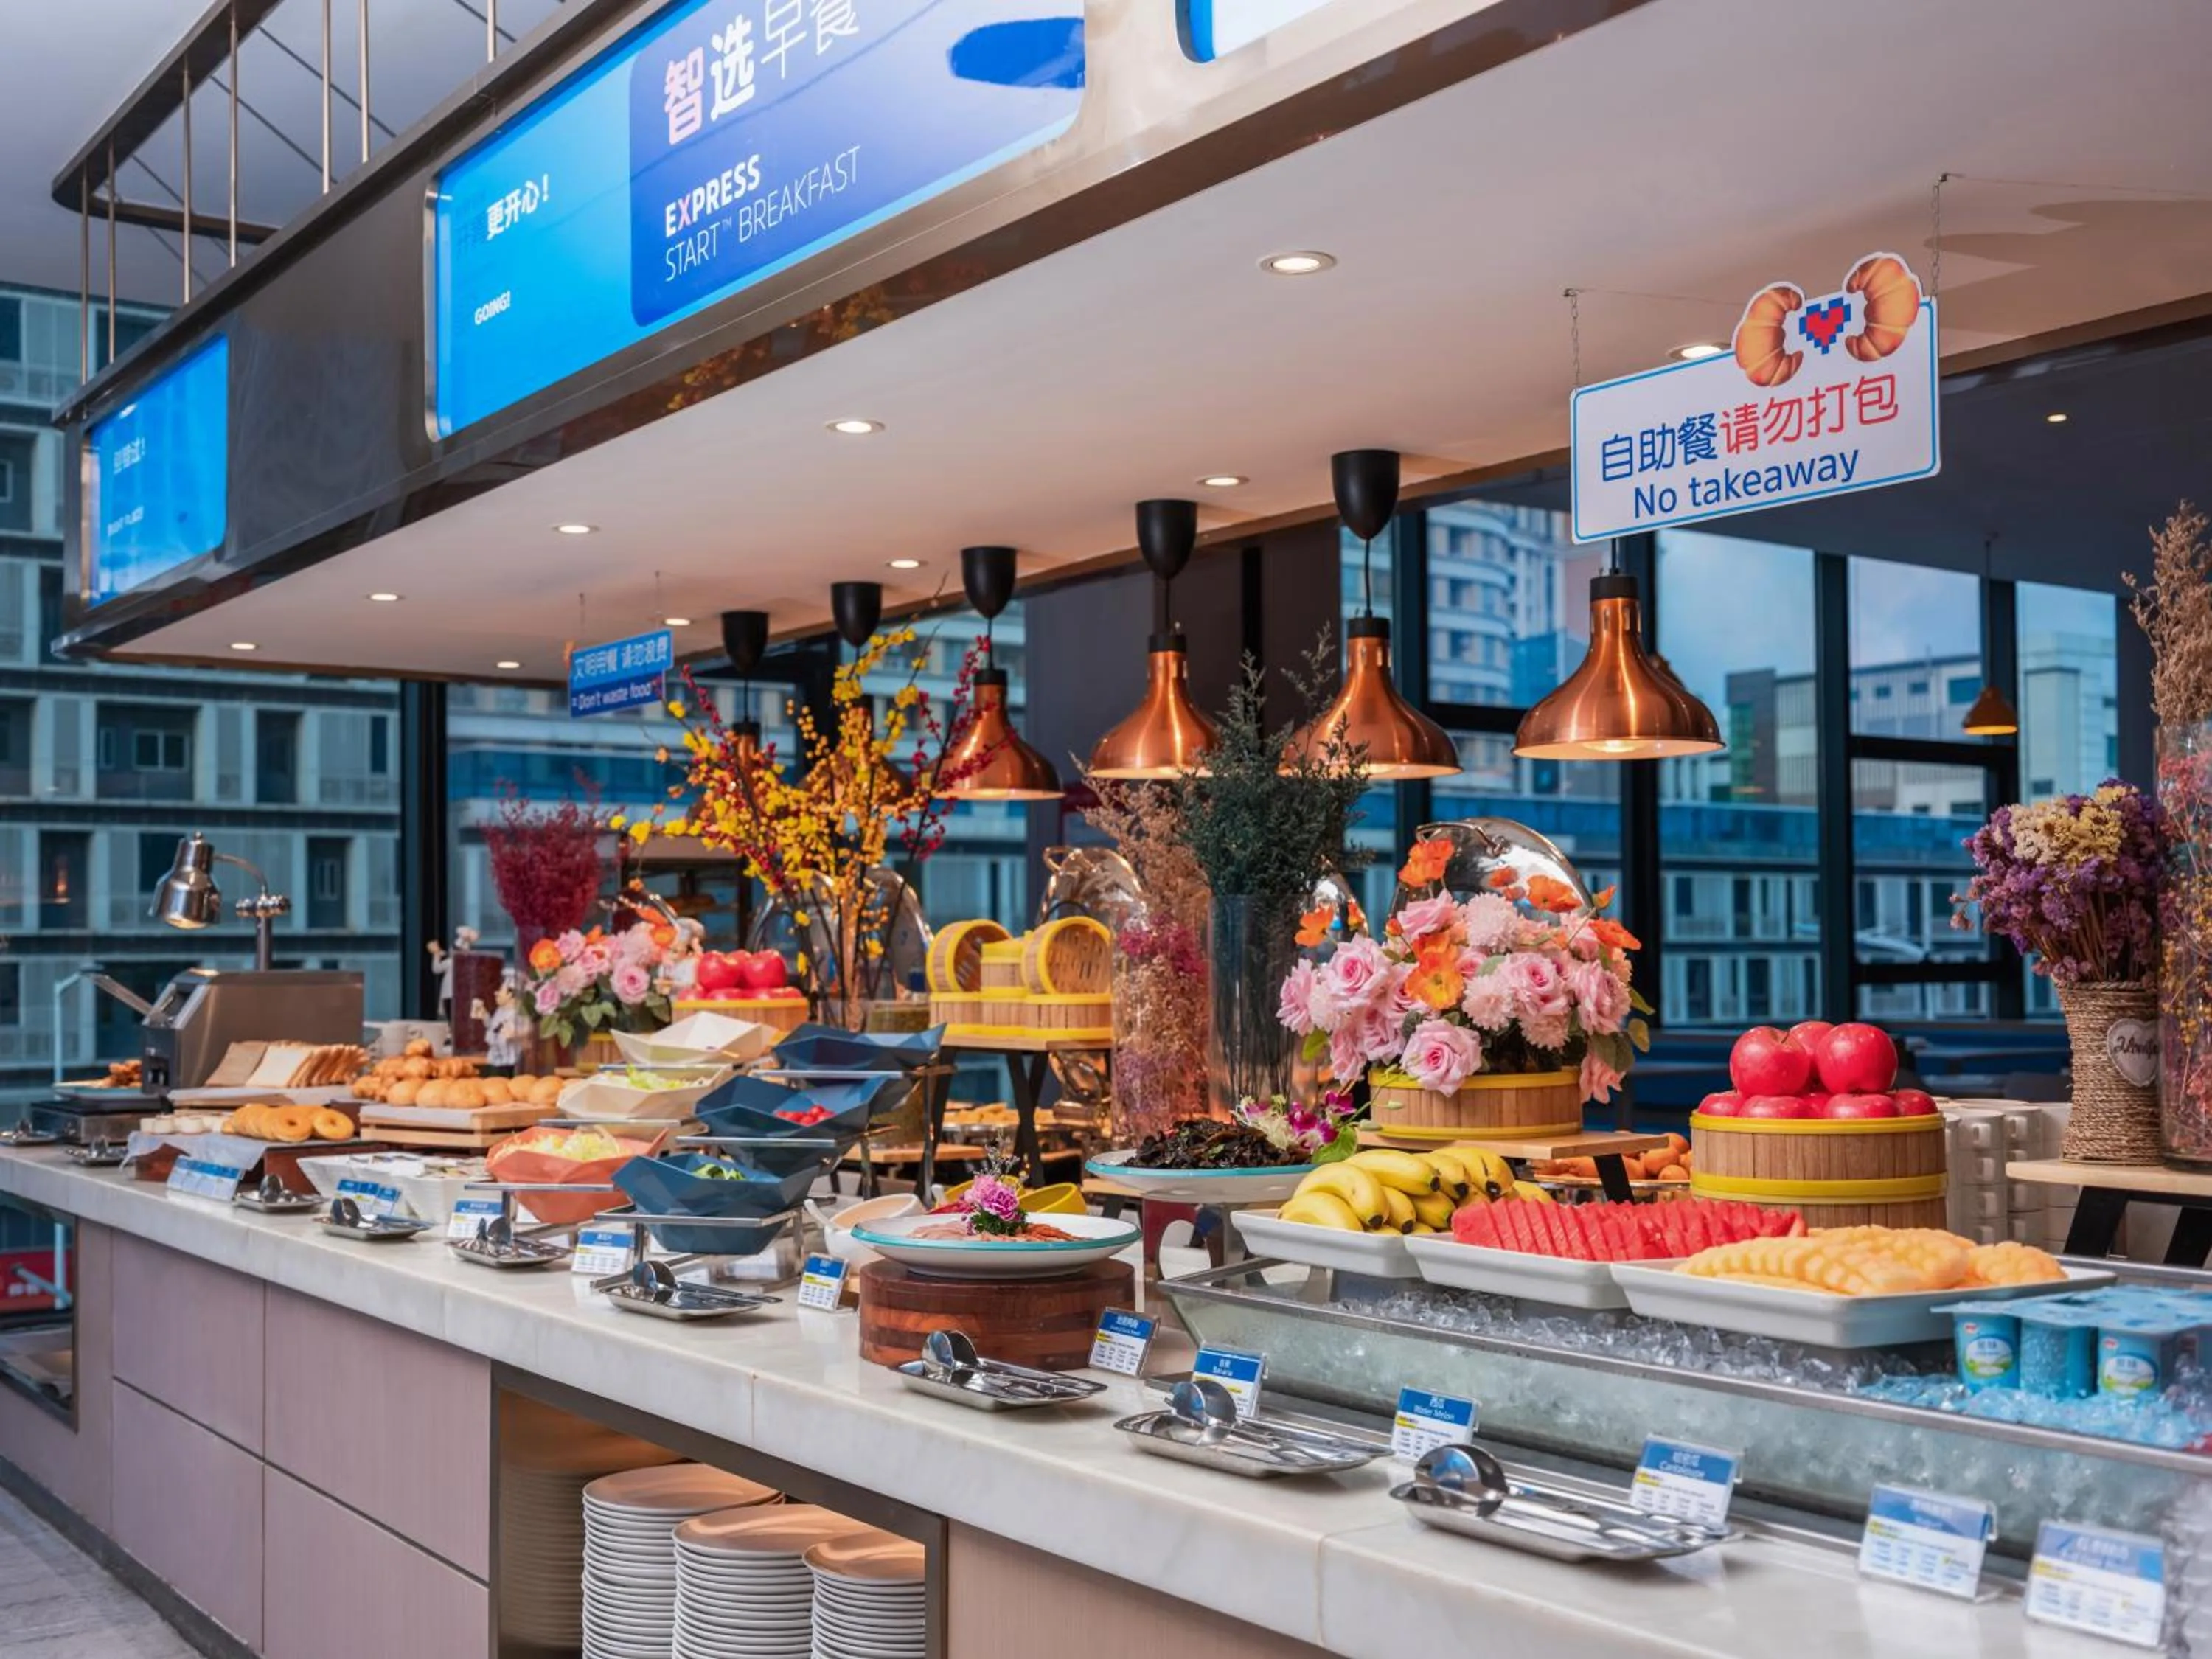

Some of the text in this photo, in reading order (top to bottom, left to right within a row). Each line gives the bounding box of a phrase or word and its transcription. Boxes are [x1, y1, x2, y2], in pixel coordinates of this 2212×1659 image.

[665, 153, 760, 238] EXPRESS
[739, 145, 861, 243] BREAKFAST
[474, 290, 511, 325] GOING!
[1601, 373, 1899, 483] 自助餐请勿打包
[1634, 449, 1860, 518] No takeaway
